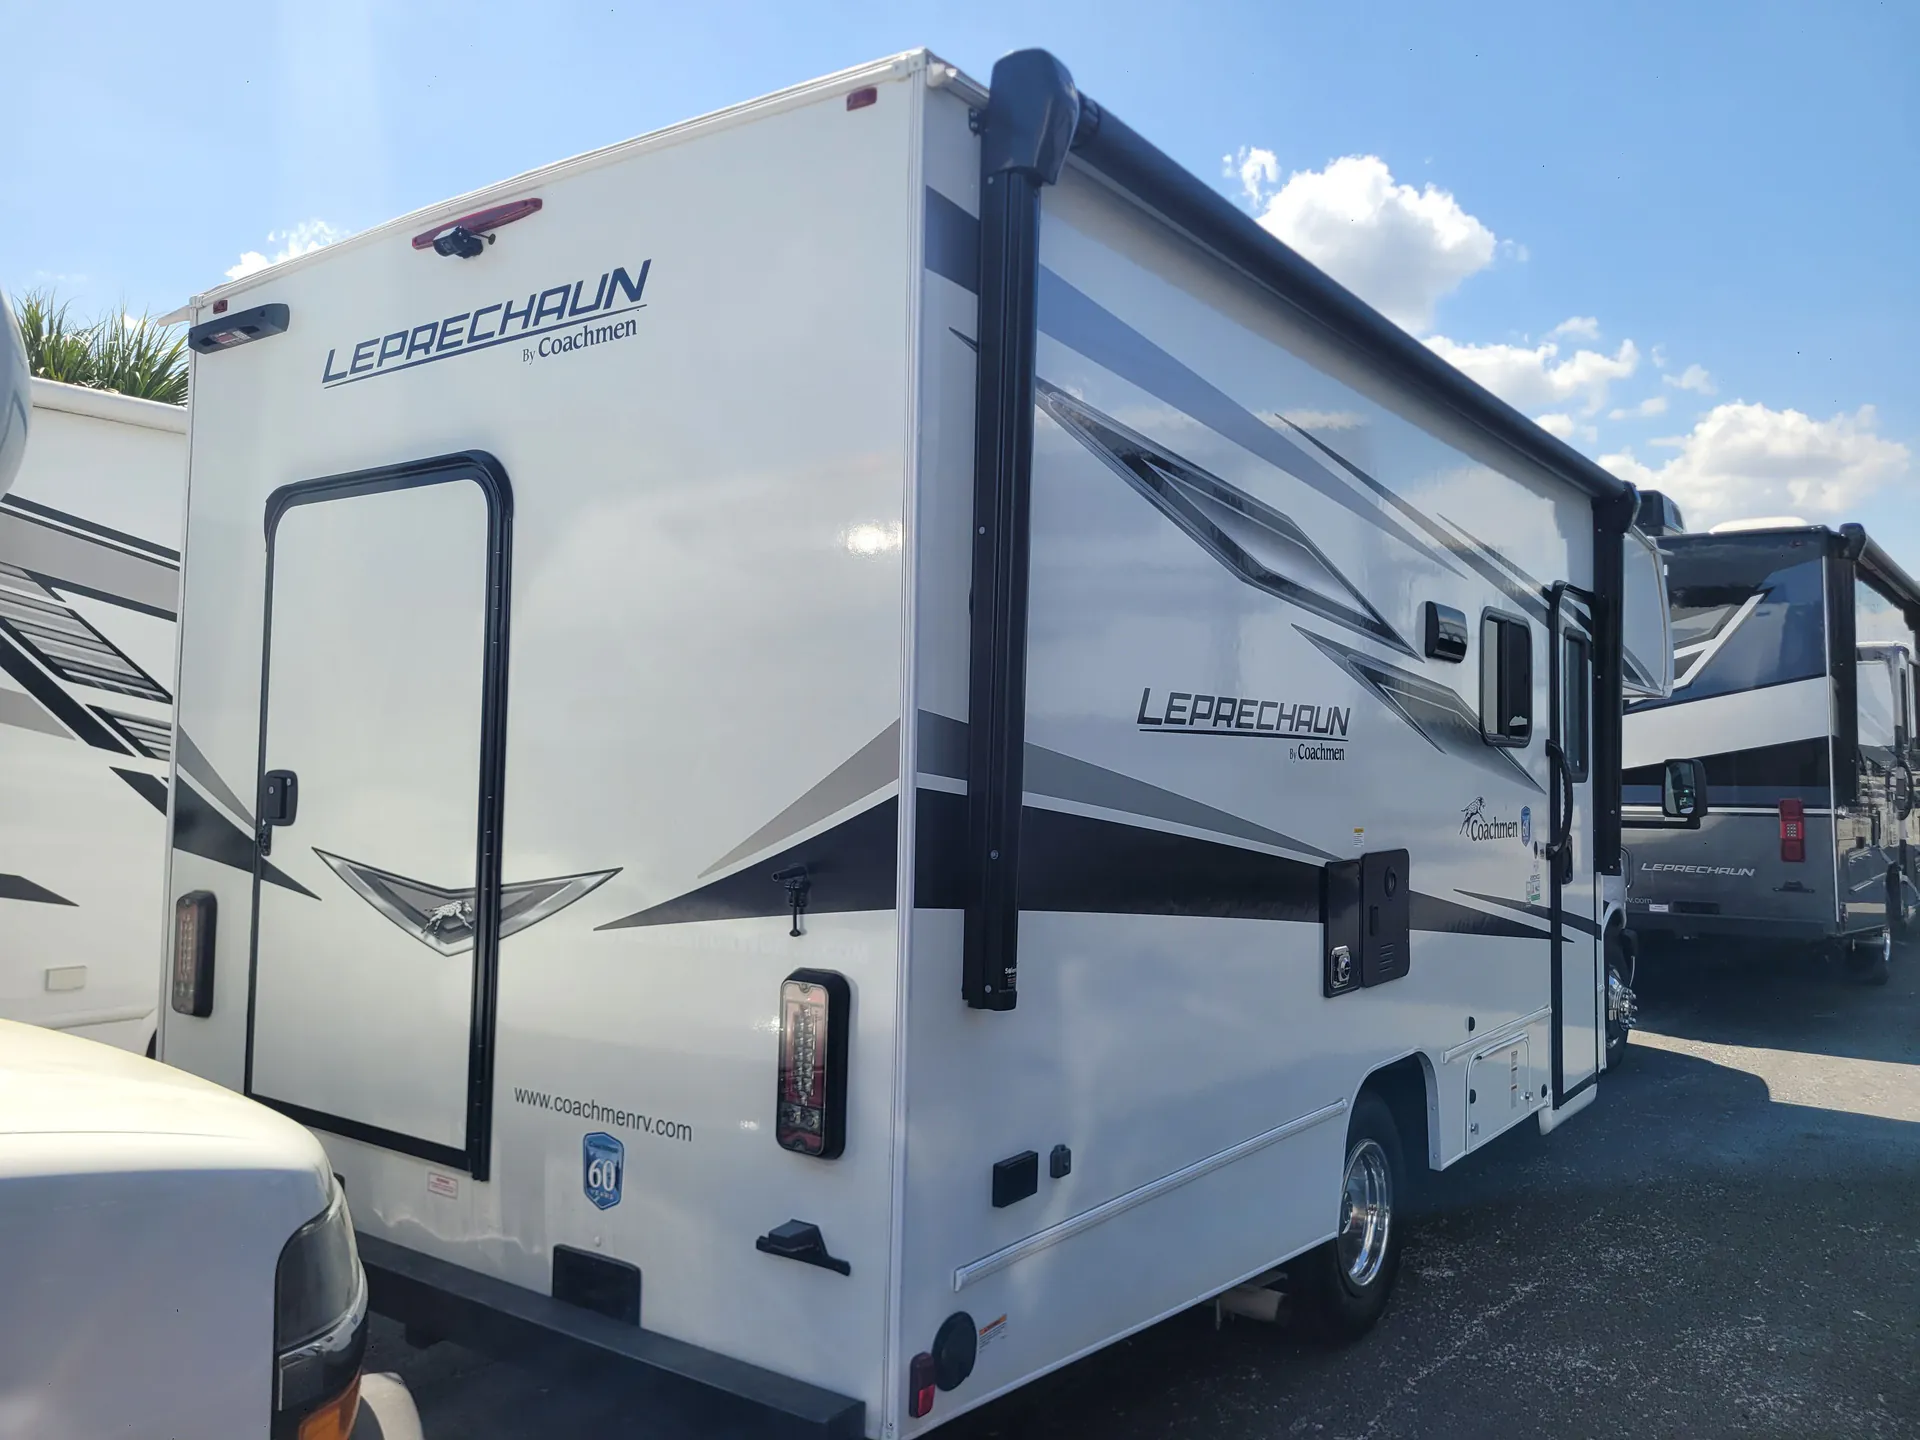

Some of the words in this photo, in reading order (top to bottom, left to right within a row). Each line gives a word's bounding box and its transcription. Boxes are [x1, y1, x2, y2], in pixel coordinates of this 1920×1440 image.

[322, 259, 652, 384] LEPRECHAUN
[522, 346, 536, 365] By
[538, 316, 637, 358] Coachmen
[1137, 687, 1350, 737] LEPRECHAUN
[1289, 747, 1297, 763] By
[1298, 743, 1345, 761] Coachmen
[1470, 816, 1518, 841] Coachmen
[1641, 863, 1755, 876] LEPRECHAUN
[514, 1087, 693, 1142] www.coachmenrv.com
[588, 1158, 616, 1191] 60
